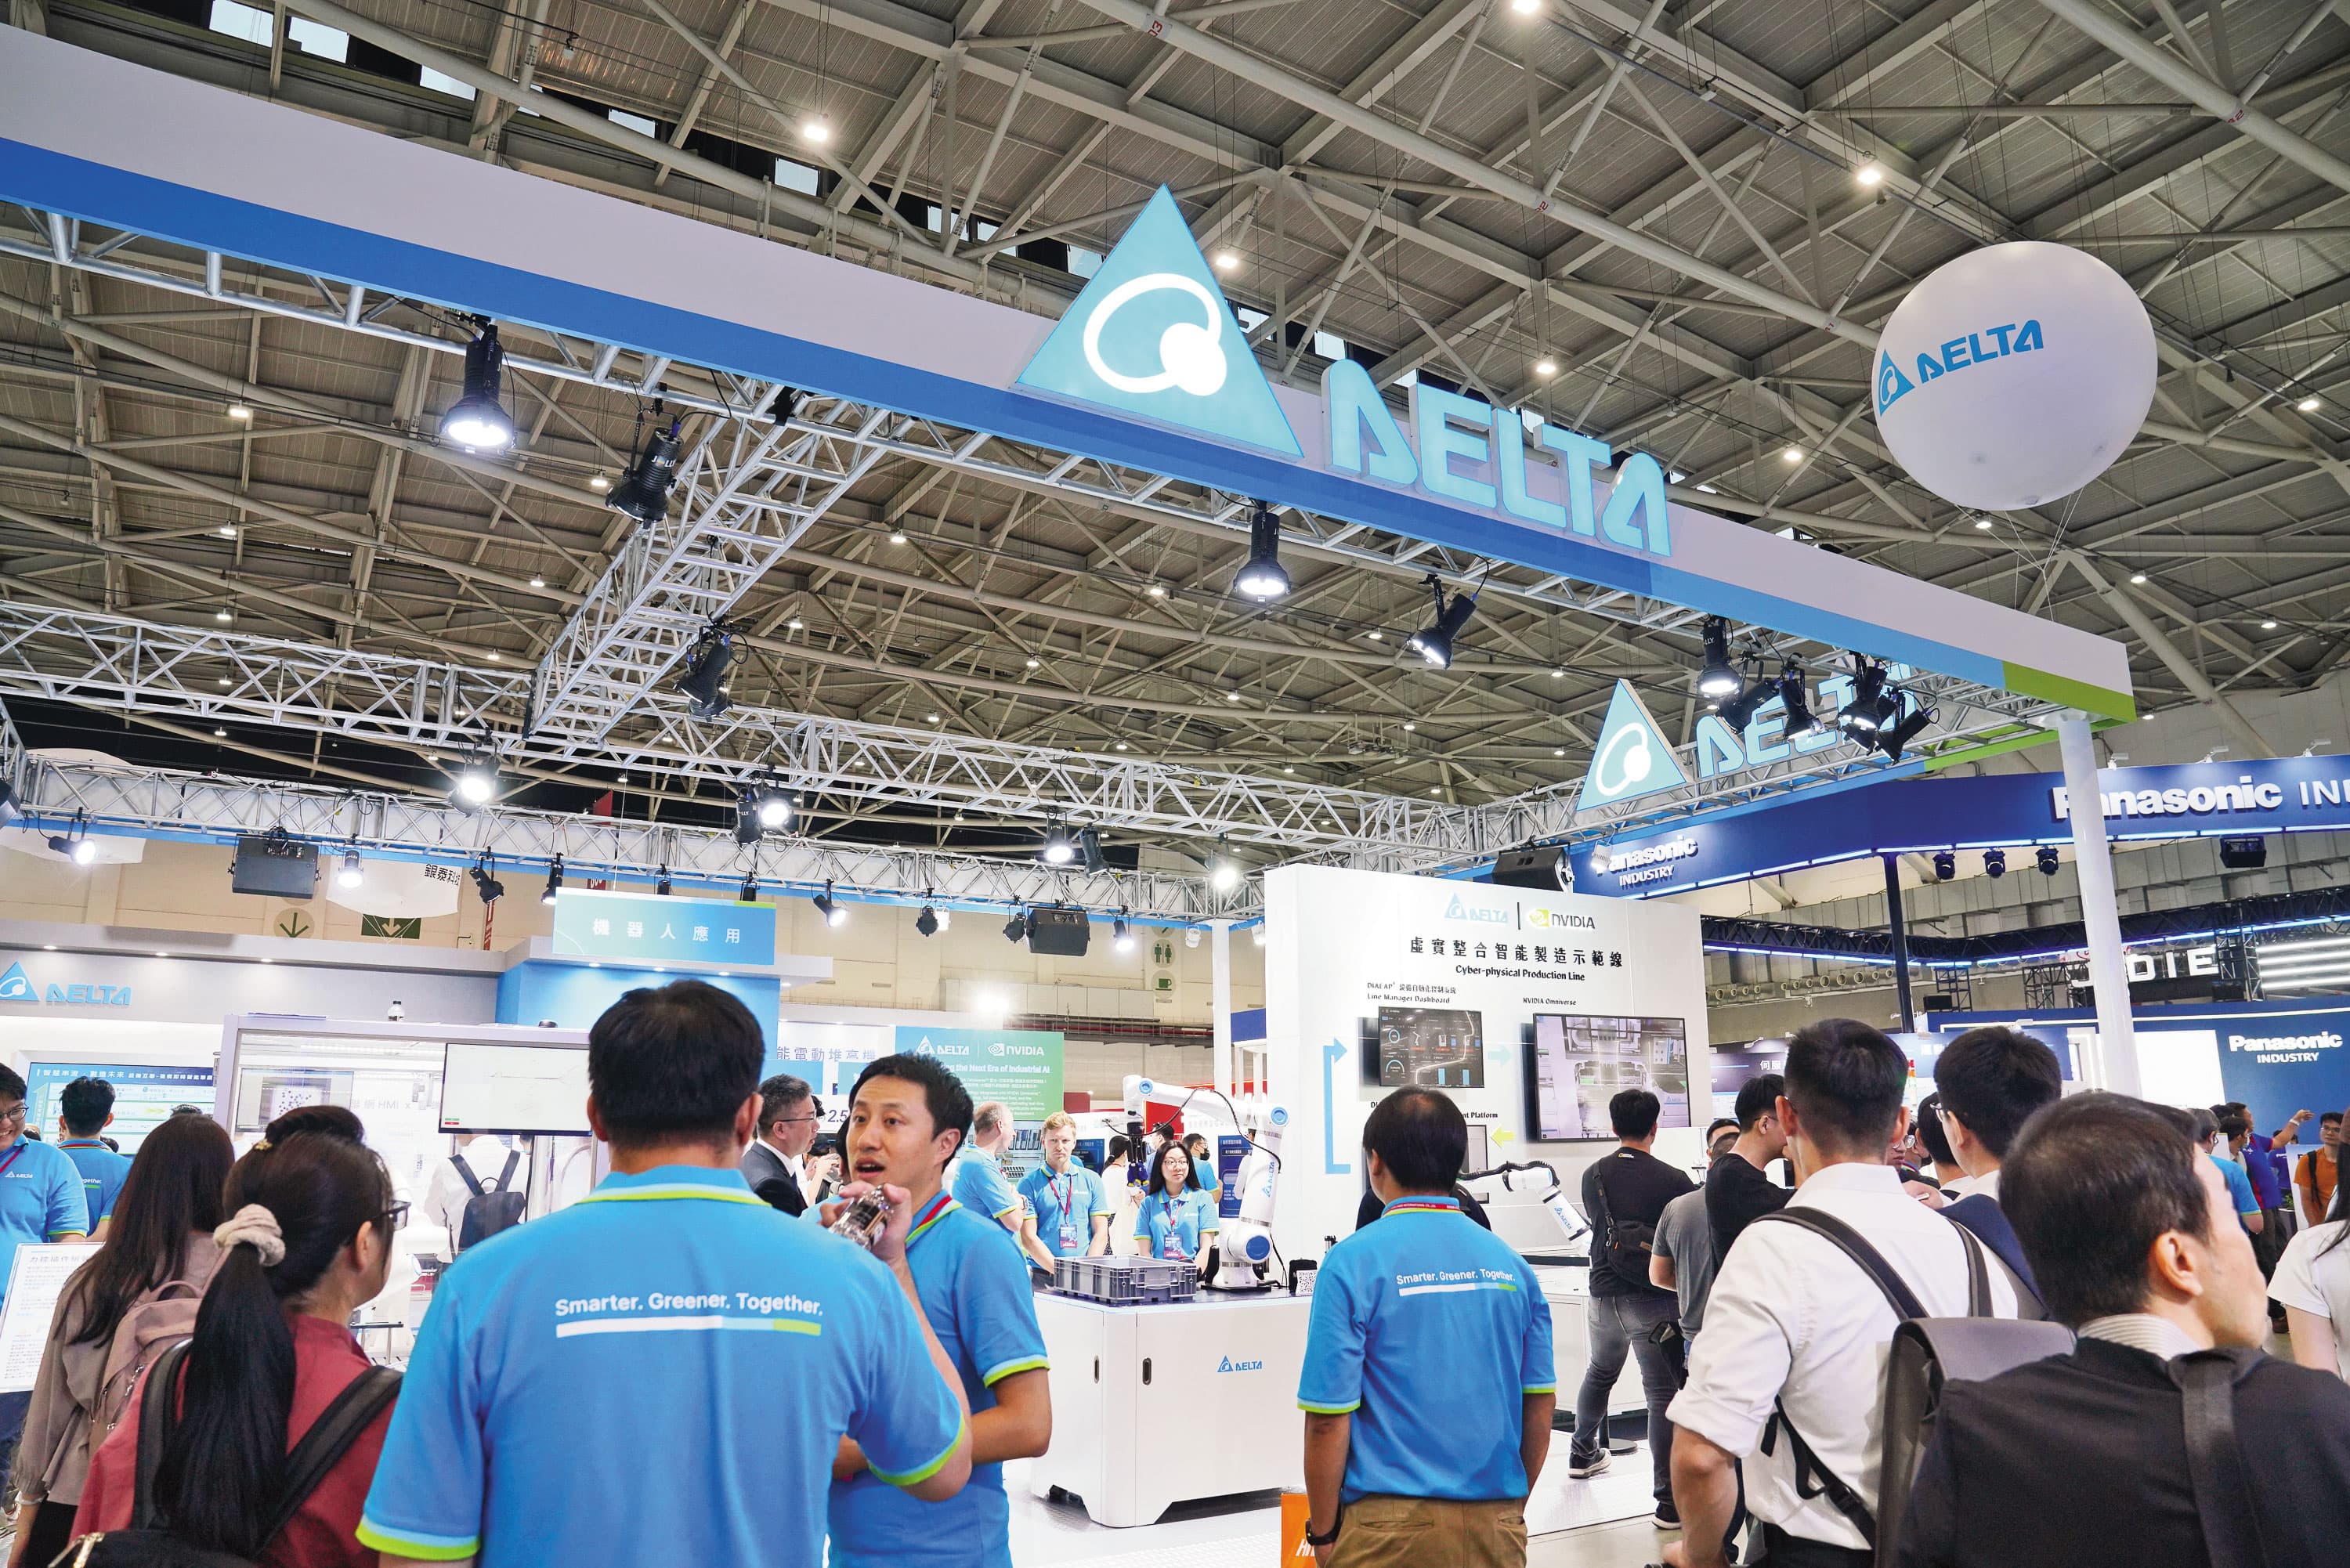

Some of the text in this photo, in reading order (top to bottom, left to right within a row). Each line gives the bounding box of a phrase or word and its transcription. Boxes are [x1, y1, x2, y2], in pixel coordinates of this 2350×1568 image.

[1916, 319, 2044, 385] DELTA
[1321, 358, 1672, 558] DELTA
[2052, 775, 2350, 819] Pnasonic IN
[1596, 834, 1698, 874] anasonic
[1619, 865, 1675, 886] INDUSTRY
[1470, 907, 1596, 930] DELTA NVIDIA
[592, 918, 740, 944] 機器人應用
[1409, 936, 1623, 968] 虛實整合智能製造示範線
[1455, 964, 1585, 981] Cyber-physical Production Line
[45, 983, 132, 1006] DELTA
[1383, 993, 1412, 1003] Manager
[1415, 995, 1450, 1003] Dashboard
[1546, 998, 1576, 1006] Omniverse
[937, 1045, 1045, 1056] DELTA NVIDIA
[2228, 1031, 2344, 1052] Panasonic
[2257, 1052, 2319, 1064] INDUSTRY
[1396, 1268, 1516, 1285] Smarter. Greener. Together.
[555, 1292, 823, 1317] Smarter. Greener. Together.
[1235, 1360, 1263, 1371] DELTA
